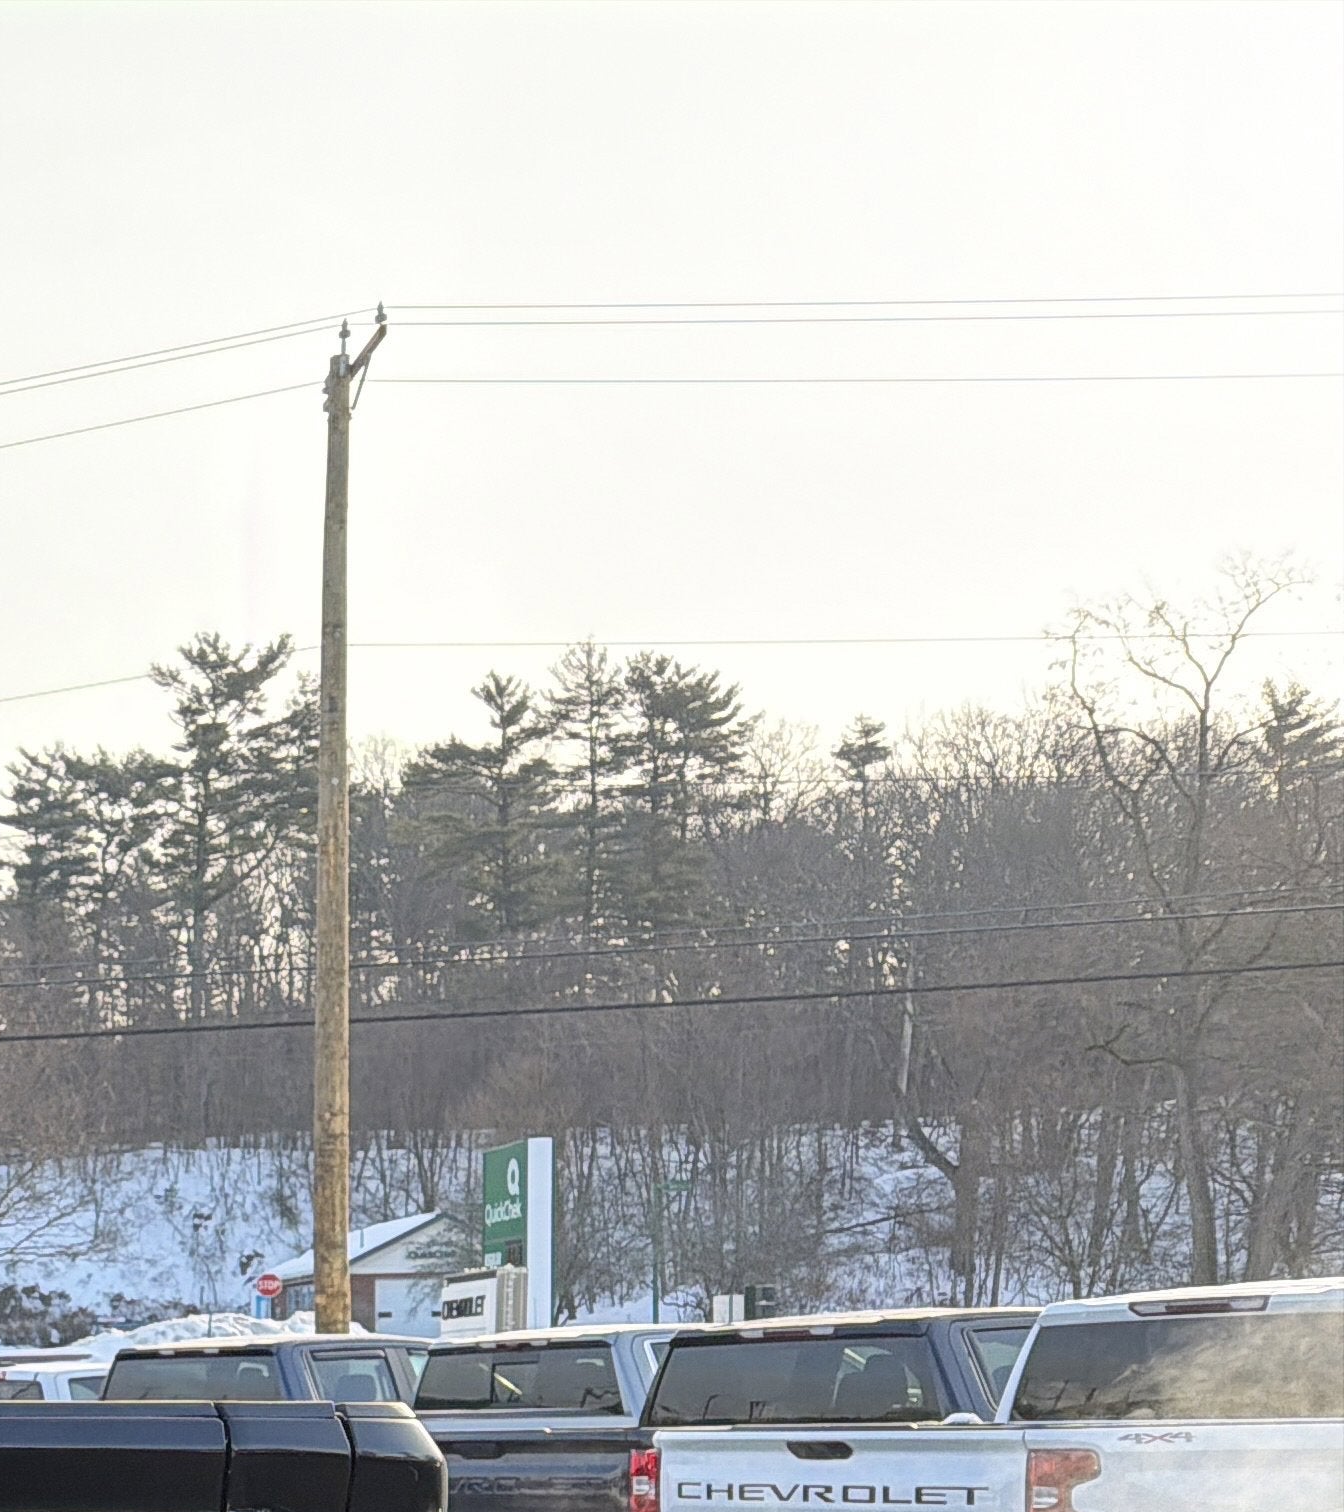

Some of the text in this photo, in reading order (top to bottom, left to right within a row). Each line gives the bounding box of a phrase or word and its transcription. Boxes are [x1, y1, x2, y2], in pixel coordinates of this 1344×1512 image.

[484, 1197, 522, 1227] QuickChek
[258, 1280, 280, 1290] STOP
[677, 1481, 990, 1506] CHEVROLET
